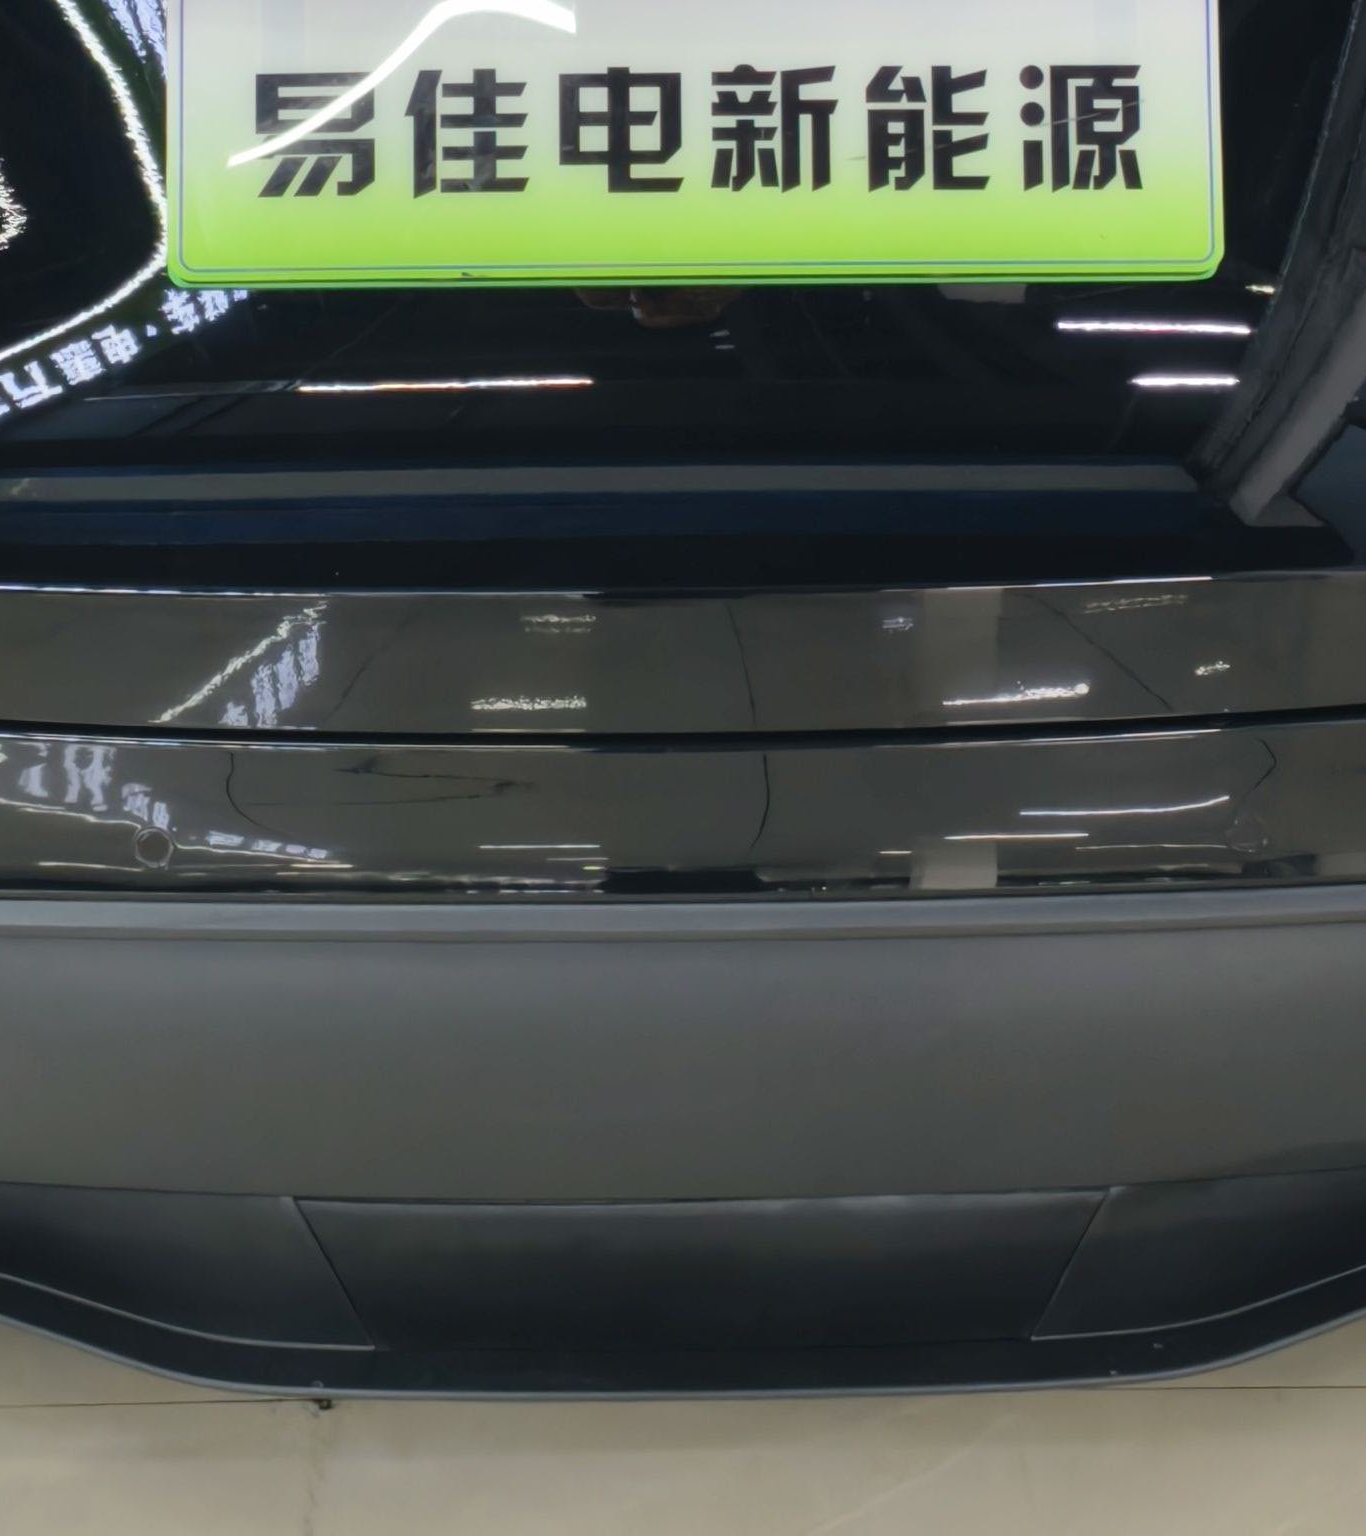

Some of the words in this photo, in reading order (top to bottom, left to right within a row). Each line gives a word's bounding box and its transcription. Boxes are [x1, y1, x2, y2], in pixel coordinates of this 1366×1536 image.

[251, 63, 1143, 199] 易佳电新能源
